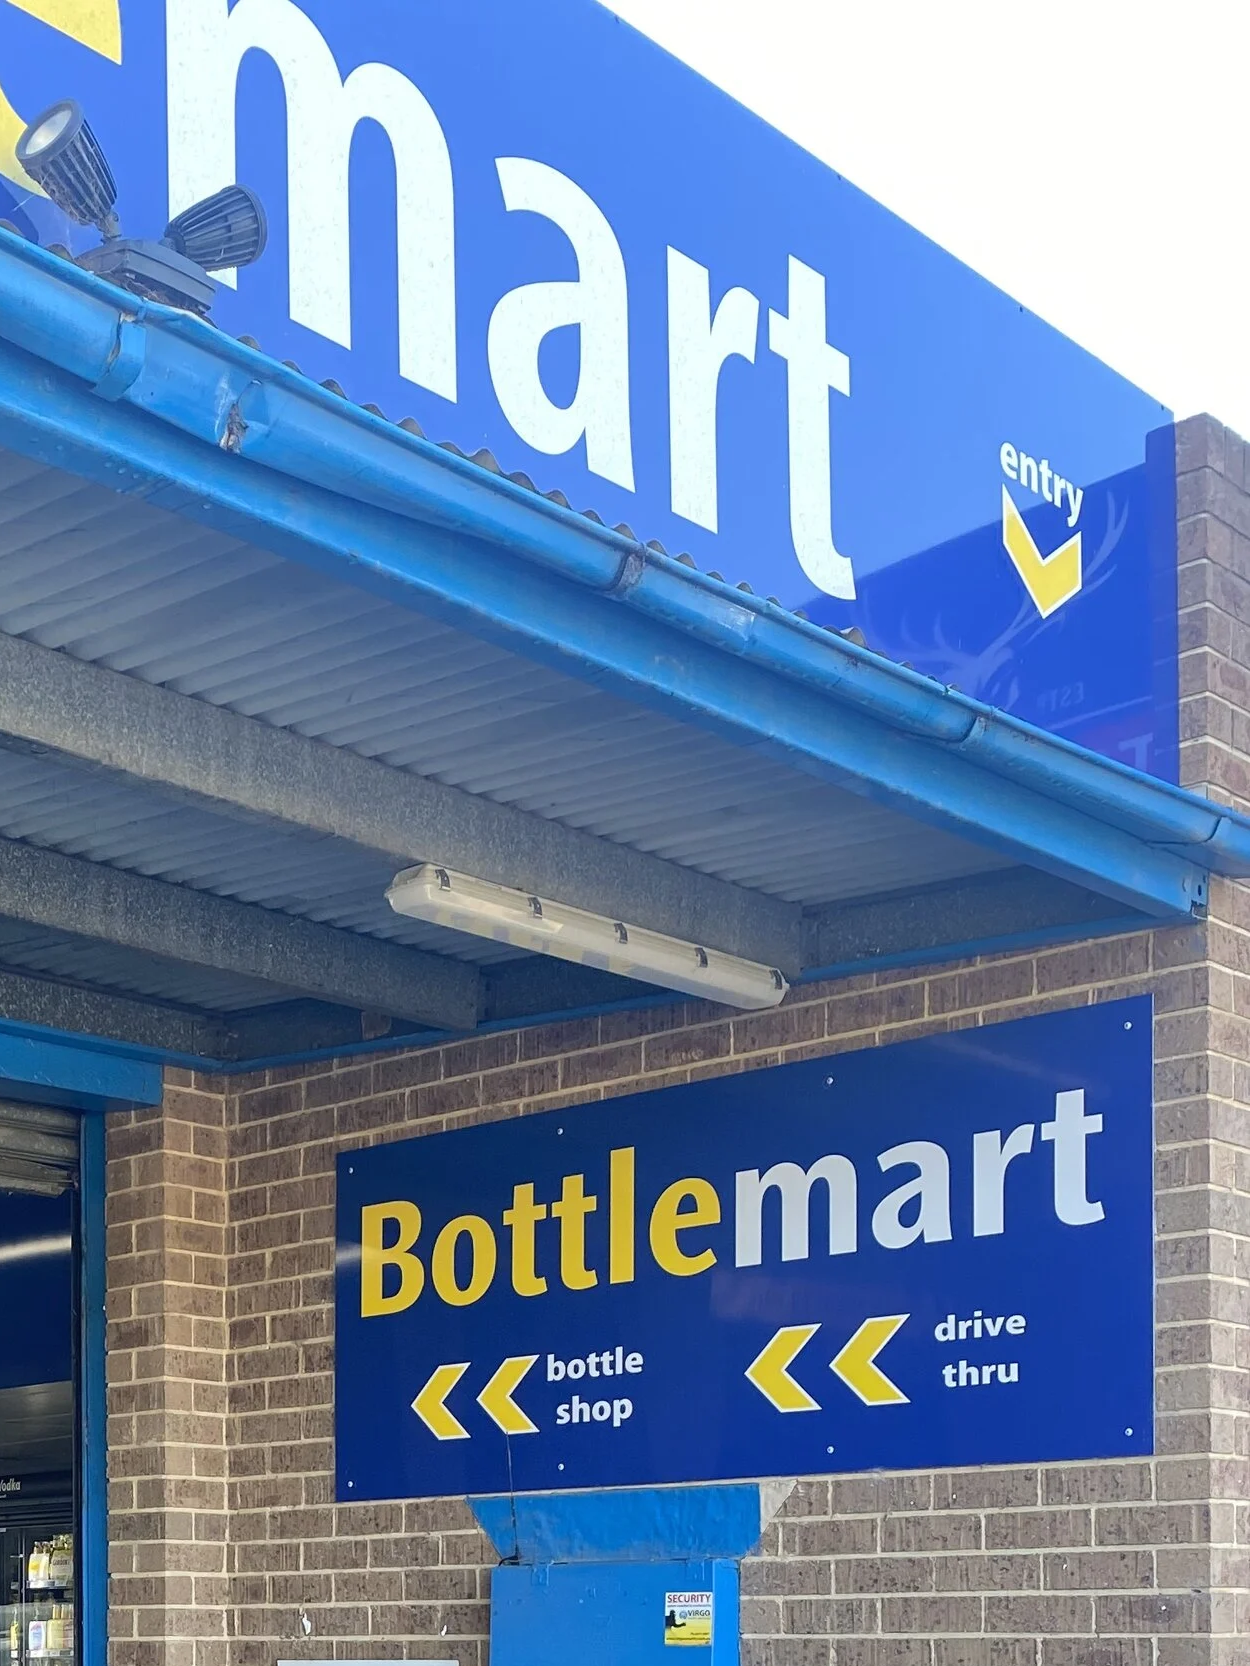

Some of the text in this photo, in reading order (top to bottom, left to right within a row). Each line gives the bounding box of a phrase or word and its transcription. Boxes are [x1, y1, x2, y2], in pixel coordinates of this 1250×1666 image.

[1000, 441, 1084, 528] entry
[359, 1087, 1108, 1318] Bottlemart
[933, 1307, 1027, 1342] drive
[544, 1345, 645, 1383] bottle
[941, 1355, 1020, 1387] thru
[555, 1391, 634, 1428] shop
[667, 1594, 711, 1604] SECURITY
[688, 1609, 711, 1617] VIRGO
